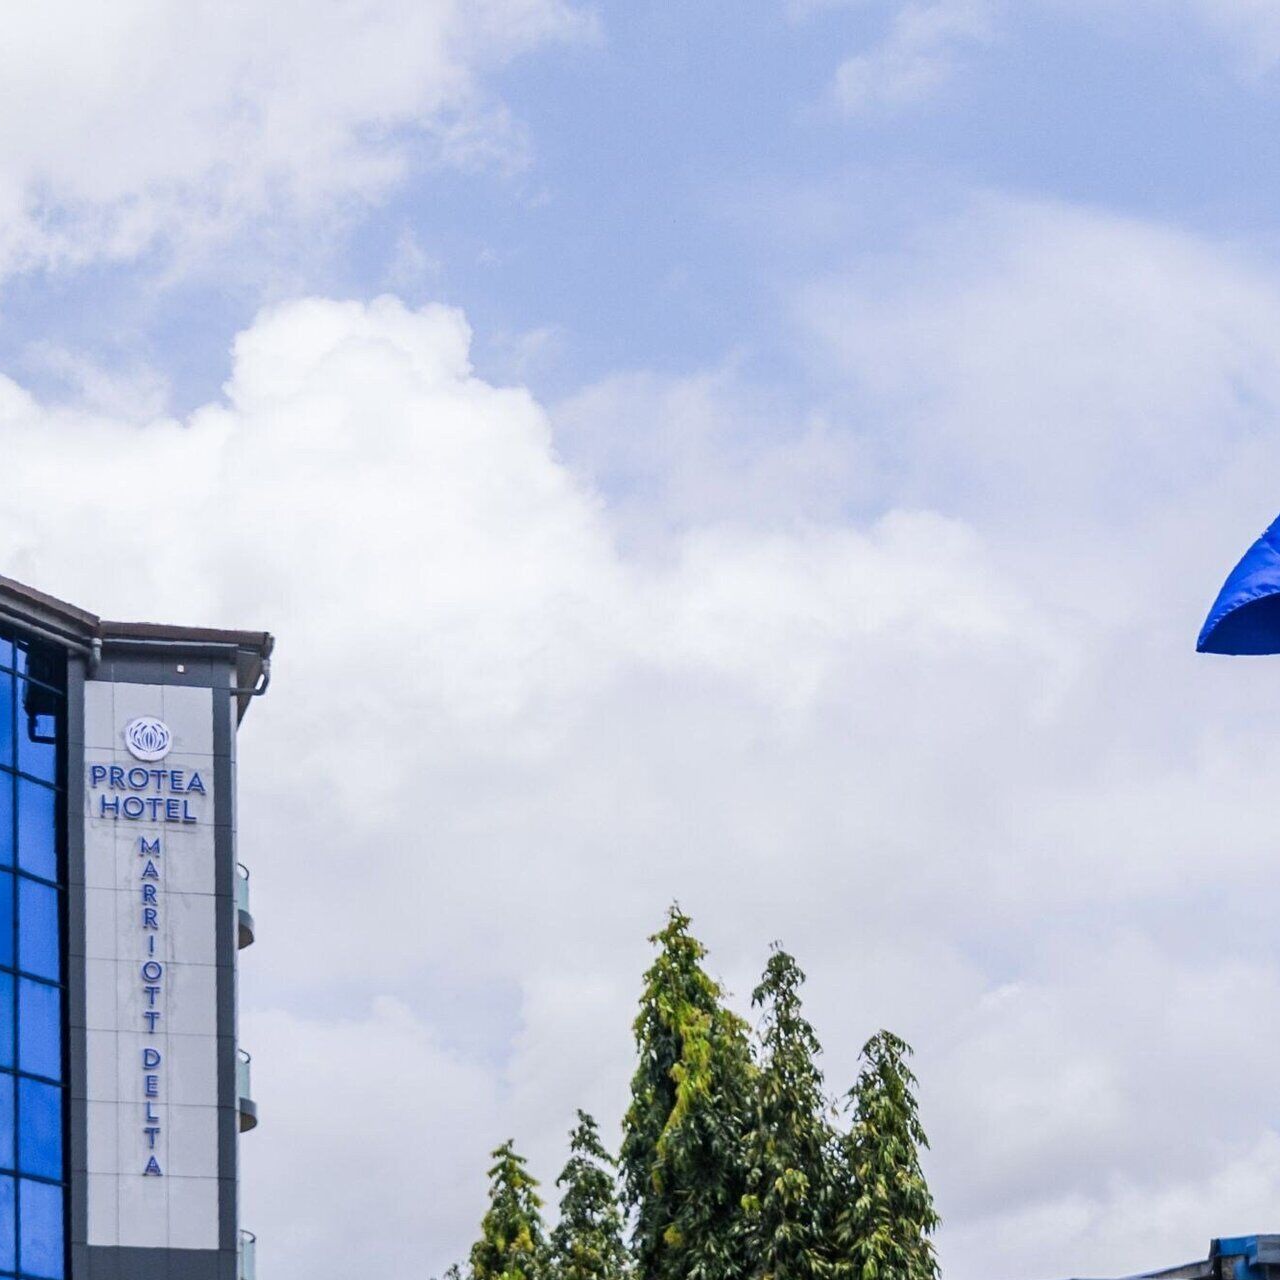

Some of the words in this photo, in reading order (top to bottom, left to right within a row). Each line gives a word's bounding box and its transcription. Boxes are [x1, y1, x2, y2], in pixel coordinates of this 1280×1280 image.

[91, 764, 206, 795] PROTEA
[100, 794, 197, 823] HOTEL
[138, 836, 163, 1035] MARRIOTT
[141, 1047, 163, 1177] DELTA
